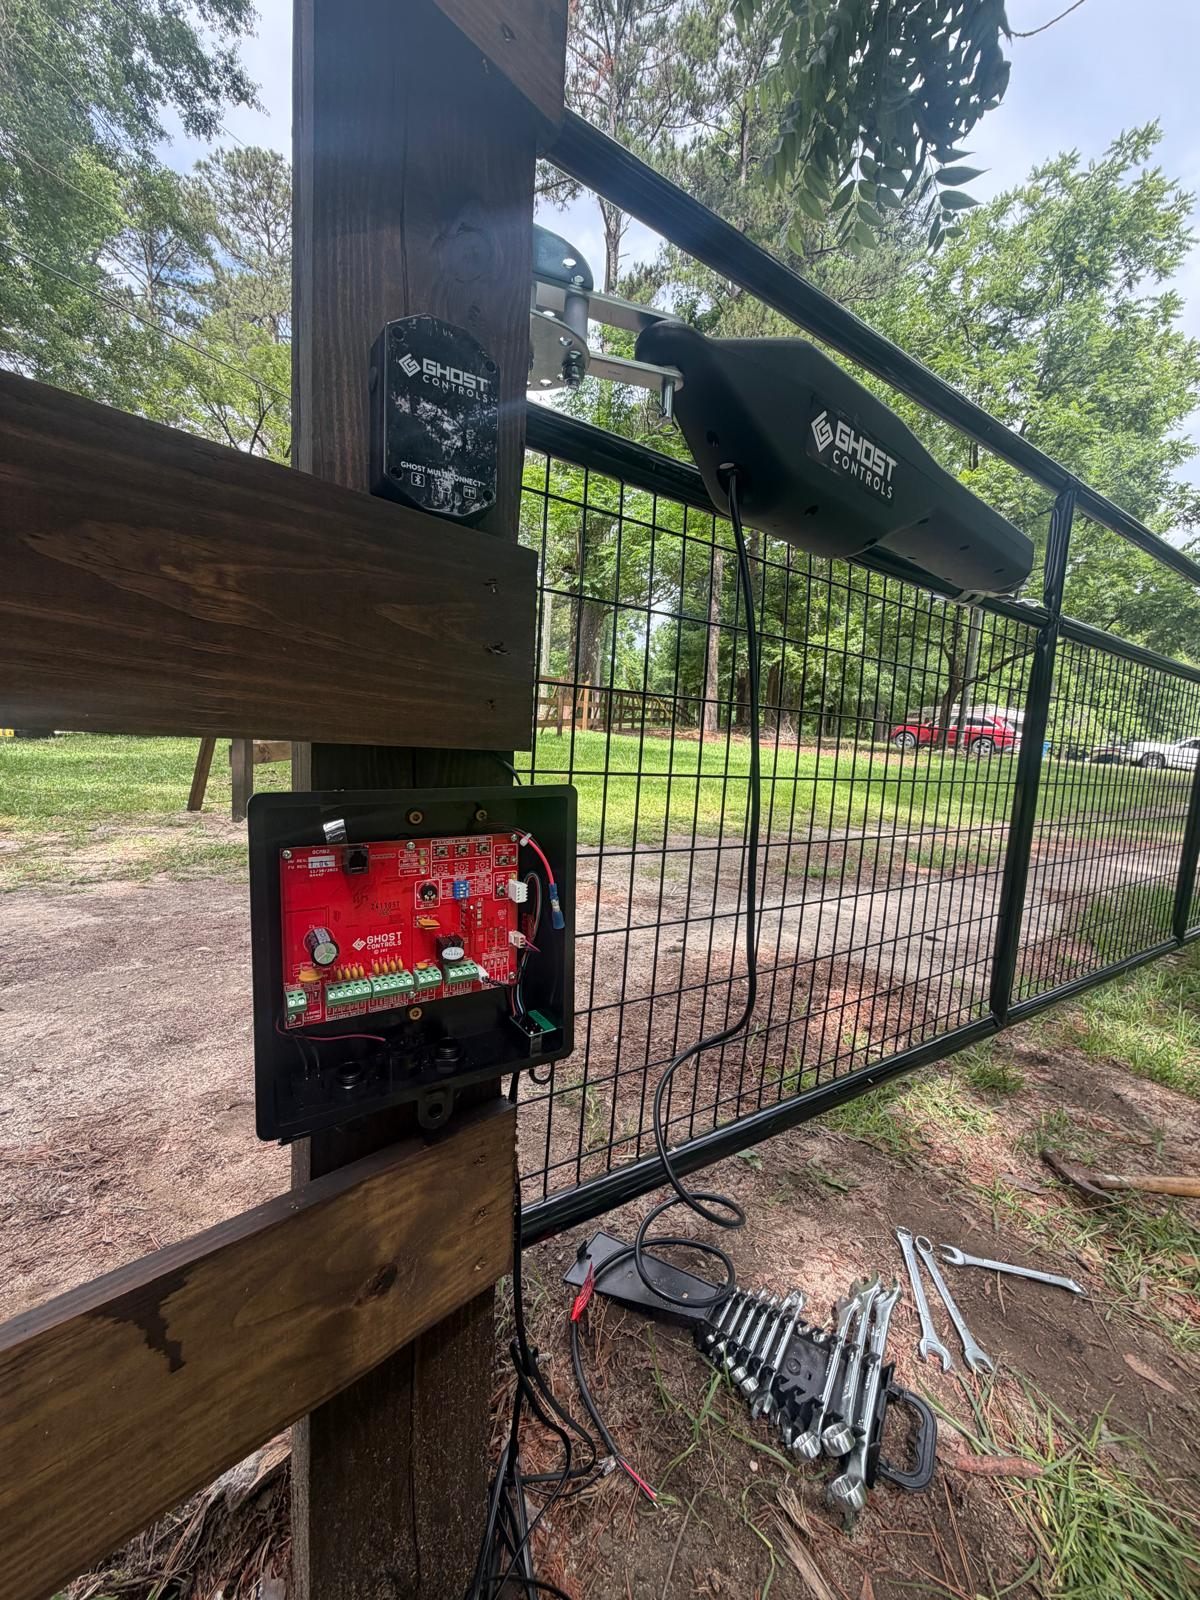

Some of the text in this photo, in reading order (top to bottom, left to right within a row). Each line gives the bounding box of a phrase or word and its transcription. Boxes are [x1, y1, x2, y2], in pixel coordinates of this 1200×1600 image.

[422, 357, 488, 392] GHOST
[422, 374, 488, 403] CONTROLS
[834, 419, 899, 482] GHOST
[400, 460, 426, 473] GHOST
[832, 449, 893, 499] CONTROLS
[366, 931, 403, 944] GHOST
[366, 939, 402, 950] CONTROLS
